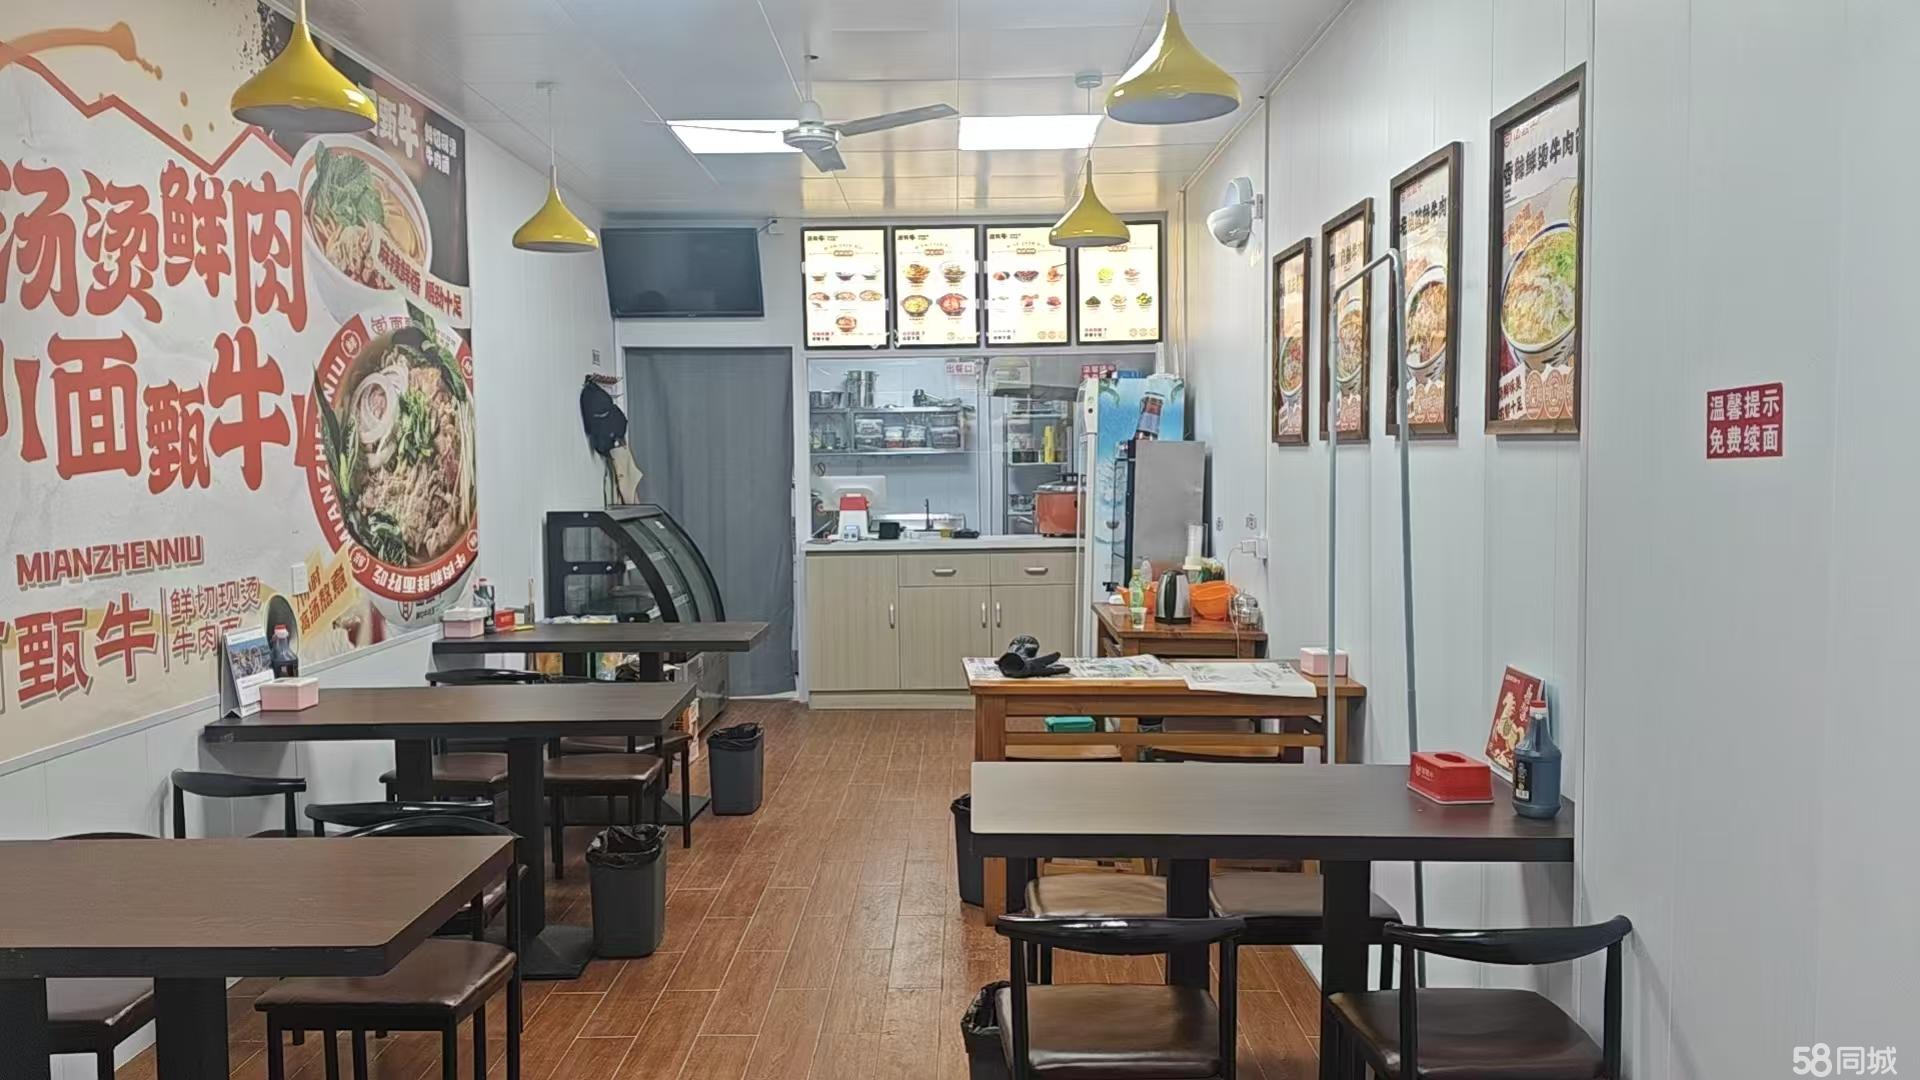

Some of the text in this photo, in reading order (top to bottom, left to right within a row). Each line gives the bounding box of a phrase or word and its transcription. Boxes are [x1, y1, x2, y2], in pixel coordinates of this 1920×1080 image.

[358, 82, 419, 158] 甄牛
[1710, 389, 1780, 421] 温馨提示
[1710, 424, 1780, 454] 免费续面
[16, 535, 203, 587] MIANZHENNIU
[372, 553, 466, 593] 牛肉新鲜面好吃
[170, 577, 261, 621] 鲜切现烫
[0, 592, 157, 703] 甄牛
